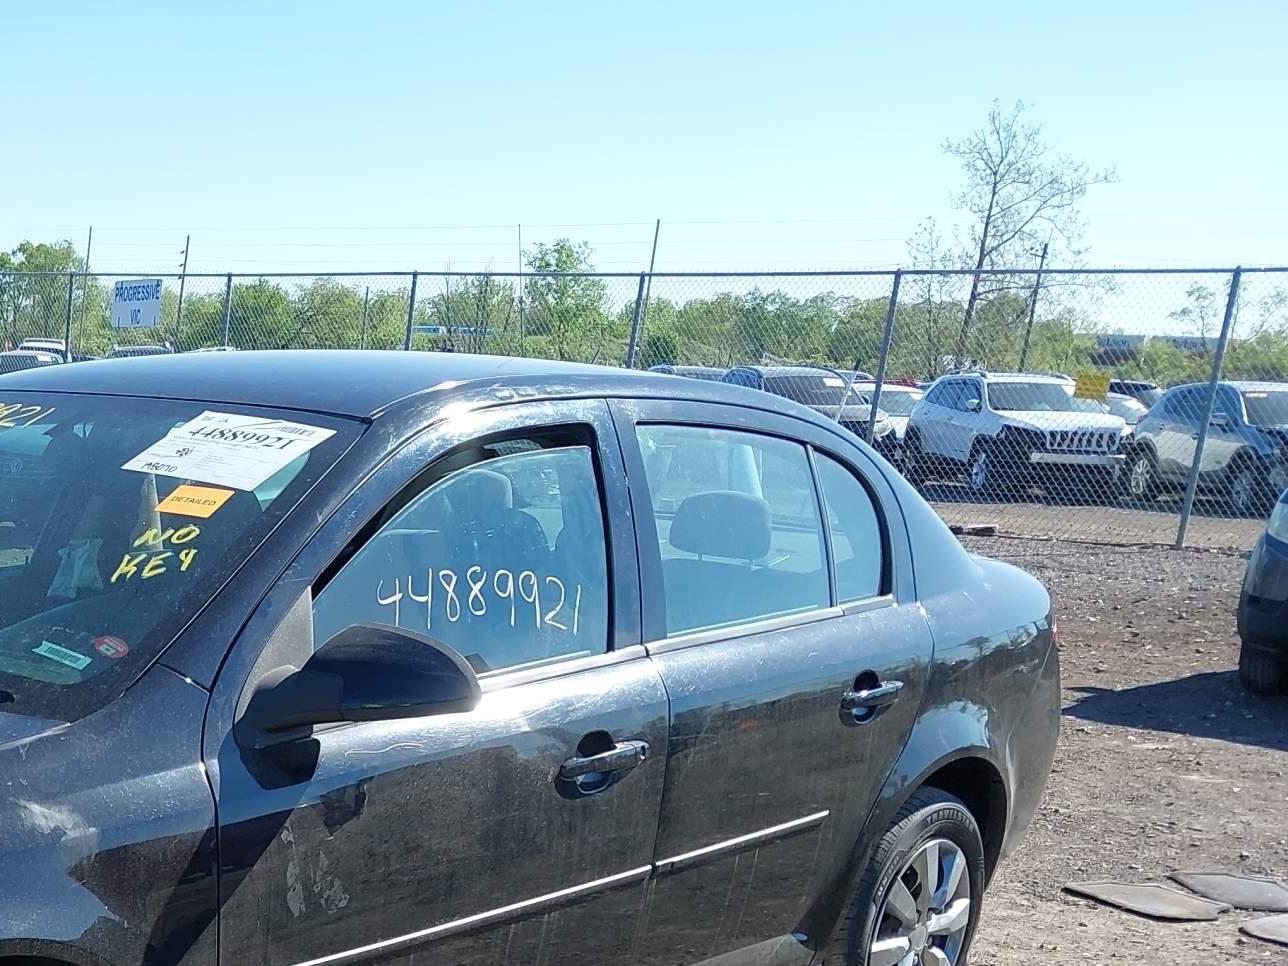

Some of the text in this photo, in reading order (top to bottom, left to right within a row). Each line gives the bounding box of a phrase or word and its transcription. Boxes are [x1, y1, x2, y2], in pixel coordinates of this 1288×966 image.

[114, 283, 161, 303] PROGRESSIVE
[189, 425, 296, 450] 44889921
[171, 495, 217, 507] DETAILED
[132, 524, 201, 547] NO
[111, 549, 198, 583] KEY
[377, 566, 582, 636] 44889921
